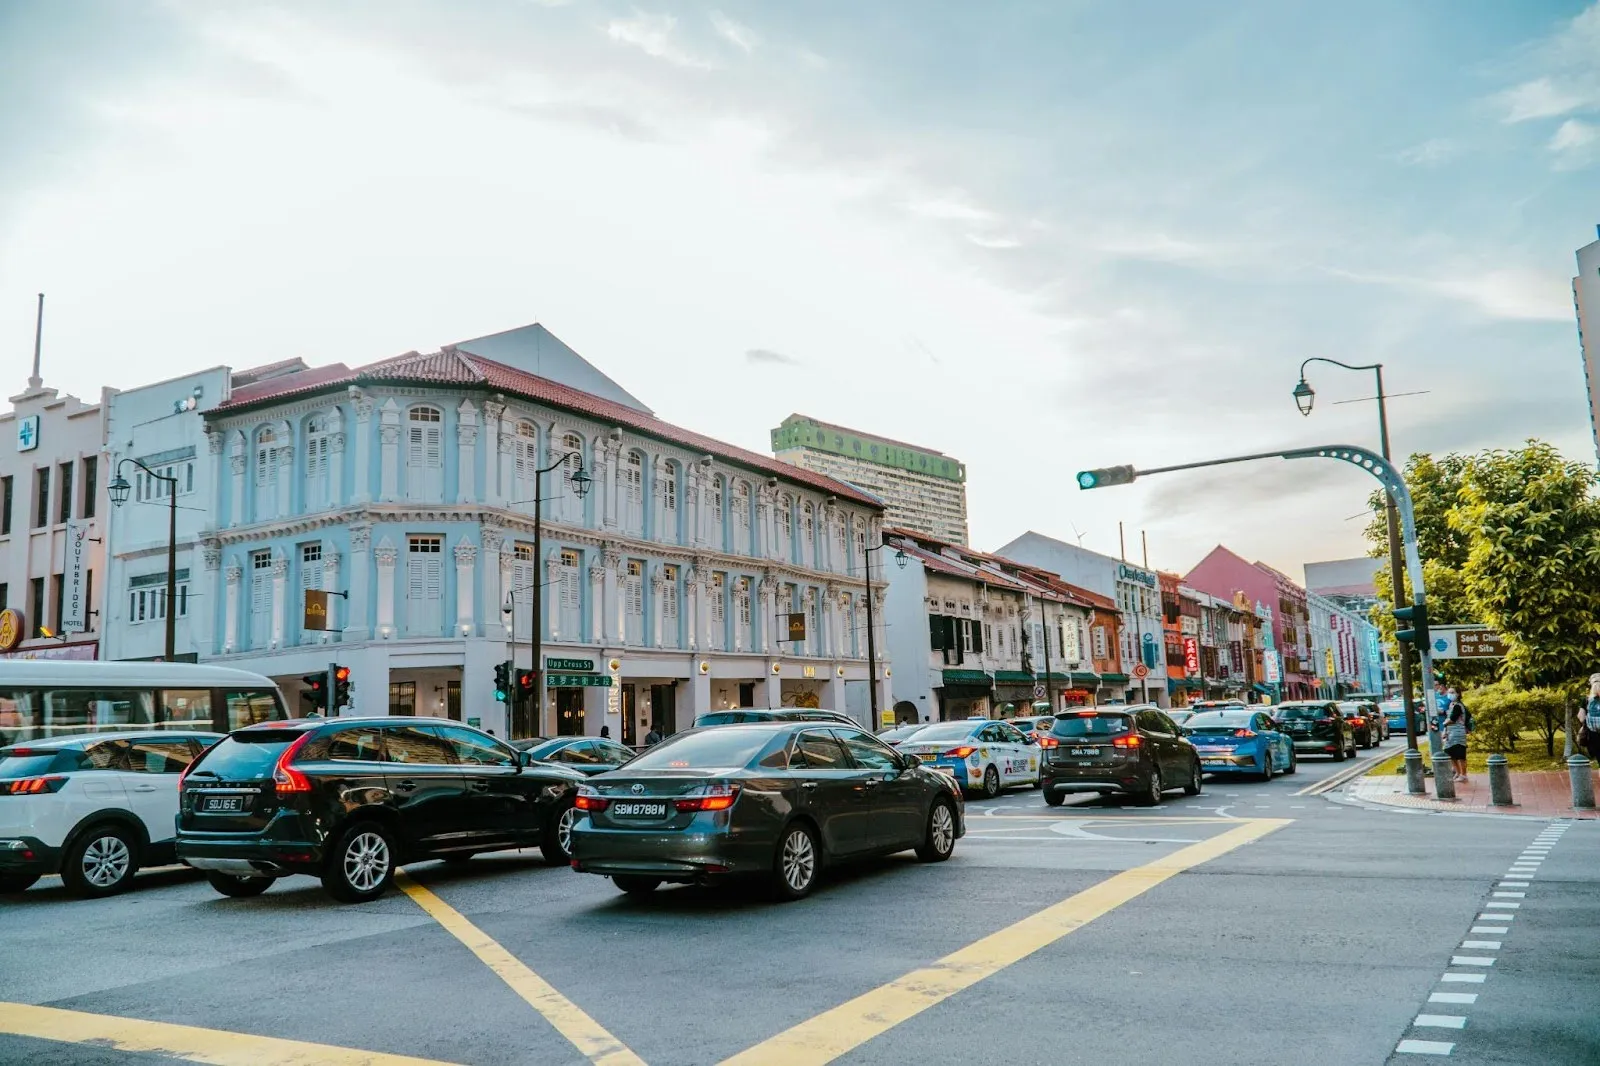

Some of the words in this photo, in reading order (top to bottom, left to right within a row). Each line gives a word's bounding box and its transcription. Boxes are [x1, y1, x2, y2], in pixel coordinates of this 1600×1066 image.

[72, 533, 82, 617] SOUTHBRIDGE
[1461, 645, 1474, 653] Ctr
[1478, 644, 1494, 653] Site
[548, 659, 562, 668] Upp
[614, 804, 666, 815] SBW8788M
